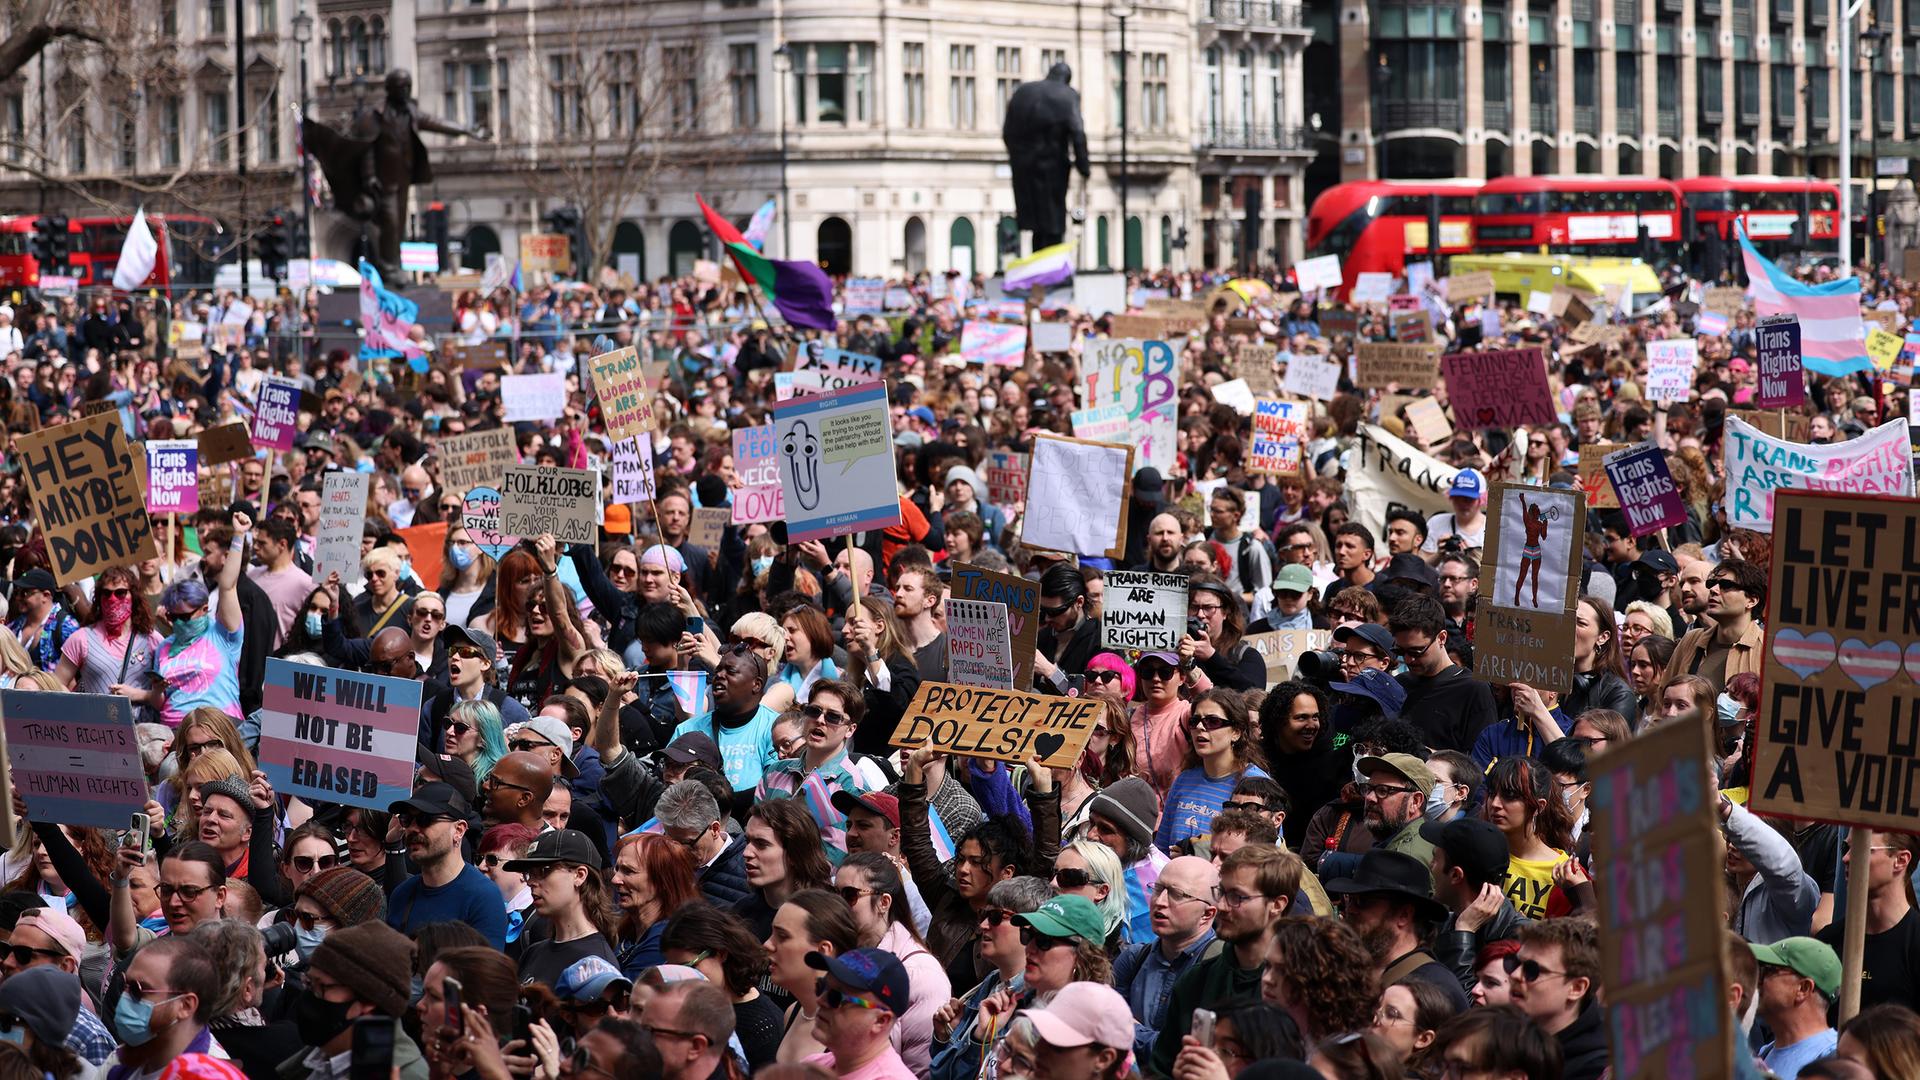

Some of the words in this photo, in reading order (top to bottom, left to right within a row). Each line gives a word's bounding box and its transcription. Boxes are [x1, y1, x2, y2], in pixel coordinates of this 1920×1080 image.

[1757, 327, 1791, 350] Trans
[594, 355, 637, 380] TRANS
[837, 354, 875, 377] FIX
[1448, 351, 1536, 376] FEMINISM
[1761, 350, 1801, 379] Rights
[262, 382, 291, 405] Trans
[599, 377, 642, 402] WOMEN
[1762, 376, 1787, 399] Now
[258, 400, 296, 426] Rights
[615, 394, 638, 413] ARE
[818, 399, 838, 408] RIGHTS
[1257, 400, 1293, 418] NOT
[607, 404, 652, 430] WOMEN
[832, 427, 848, 436] trying
[855, 421, 881, 431] overthrow
[835, 418, 850, 426] looks
[850, 415, 860, 423] like
[861, 414, 872, 422] you
[254, 418, 280, 442] Now
[863, 428, 881, 437] Would
[23, 421, 133, 492] HEY,
[148, 447, 187, 468] Trans
[443, 456, 463, 470] ARE
[466, 451, 487, 465] NOT
[489, 449, 513, 461] YOUR
[614, 441, 638, 457] AND
[824, 446, 833, 454] you
[1253, 442, 1290, 457] NOT
[1731, 431, 1819, 474] TRANS
[1823, 435, 1908, 481] RIGHTS
[538, 466, 558, 476] OUR
[615, 459, 651, 474] TRANS
[758, 456, 775, 466] ARE
[1607, 457, 1656, 485] Trans
[150, 467, 196, 490] Rights
[325, 477, 338, 489] FIX
[341, 476, 360, 489] YOUR
[503, 471, 594, 499] FOLKLORE
[617, 479, 654, 497] RIGHTS
[1619, 474, 1674, 506] Rights
[1742, 465, 1793, 489] ARE
[1804, 473, 1902, 494] HUMAN
[38, 470, 132, 532] MAYBE
[151, 487, 182, 506] Now
[514, 493, 538, 505] WILL
[540, 496, 577, 509] OUTLIVE
[534, 505, 558, 517] YOUR
[1627, 503, 1665, 529] Now
[1784, 508, 1887, 569] LET
[1104, 571, 1150, 587] TRANS
[1152, 574, 1189, 588] RIGHTS
[957, 570, 1037, 614] TRANS
[1127, 587, 1155, 604] ARE
[1779, 565, 1870, 631] LIVE
[1104, 608, 1165, 627] HUMAN
[1487, 610, 1532, 633] TRANS
[948, 624, 985, 641] WOMEN
[985, 628, 1005, 644] ARE
[1108, 628, 1176, 649] RIGHTS!
[951, 638, 984, 659] RAPED
[986, 644, 1001, 652] NOT
[1481, 653, 1506, 678] ARE
[1511, 660, 1568, 688] WOMEN
[293, 671, 327, 703] WE
[335, 678, 387, 714] WILL
[922, 686, 1041, 724] PROTECT
[1043, 701, 1097, 730] THE
[1768, 683, 1866, 752] GIVE
[23, 723, 70, 743] TRANS
[76, 727, 127, 746] RIGHTS
[294, 712, 339, 746] NOT
[345, 721, 374, 753] BE
[900, 716, 1035, 760] DOLLS!
[27, 772, 81, 794] HUMAN
[86, 777, 139, 797] RIGHTS
[291, 757, 379, 799] ERASED
[1763, 746, 1805, 804] A
